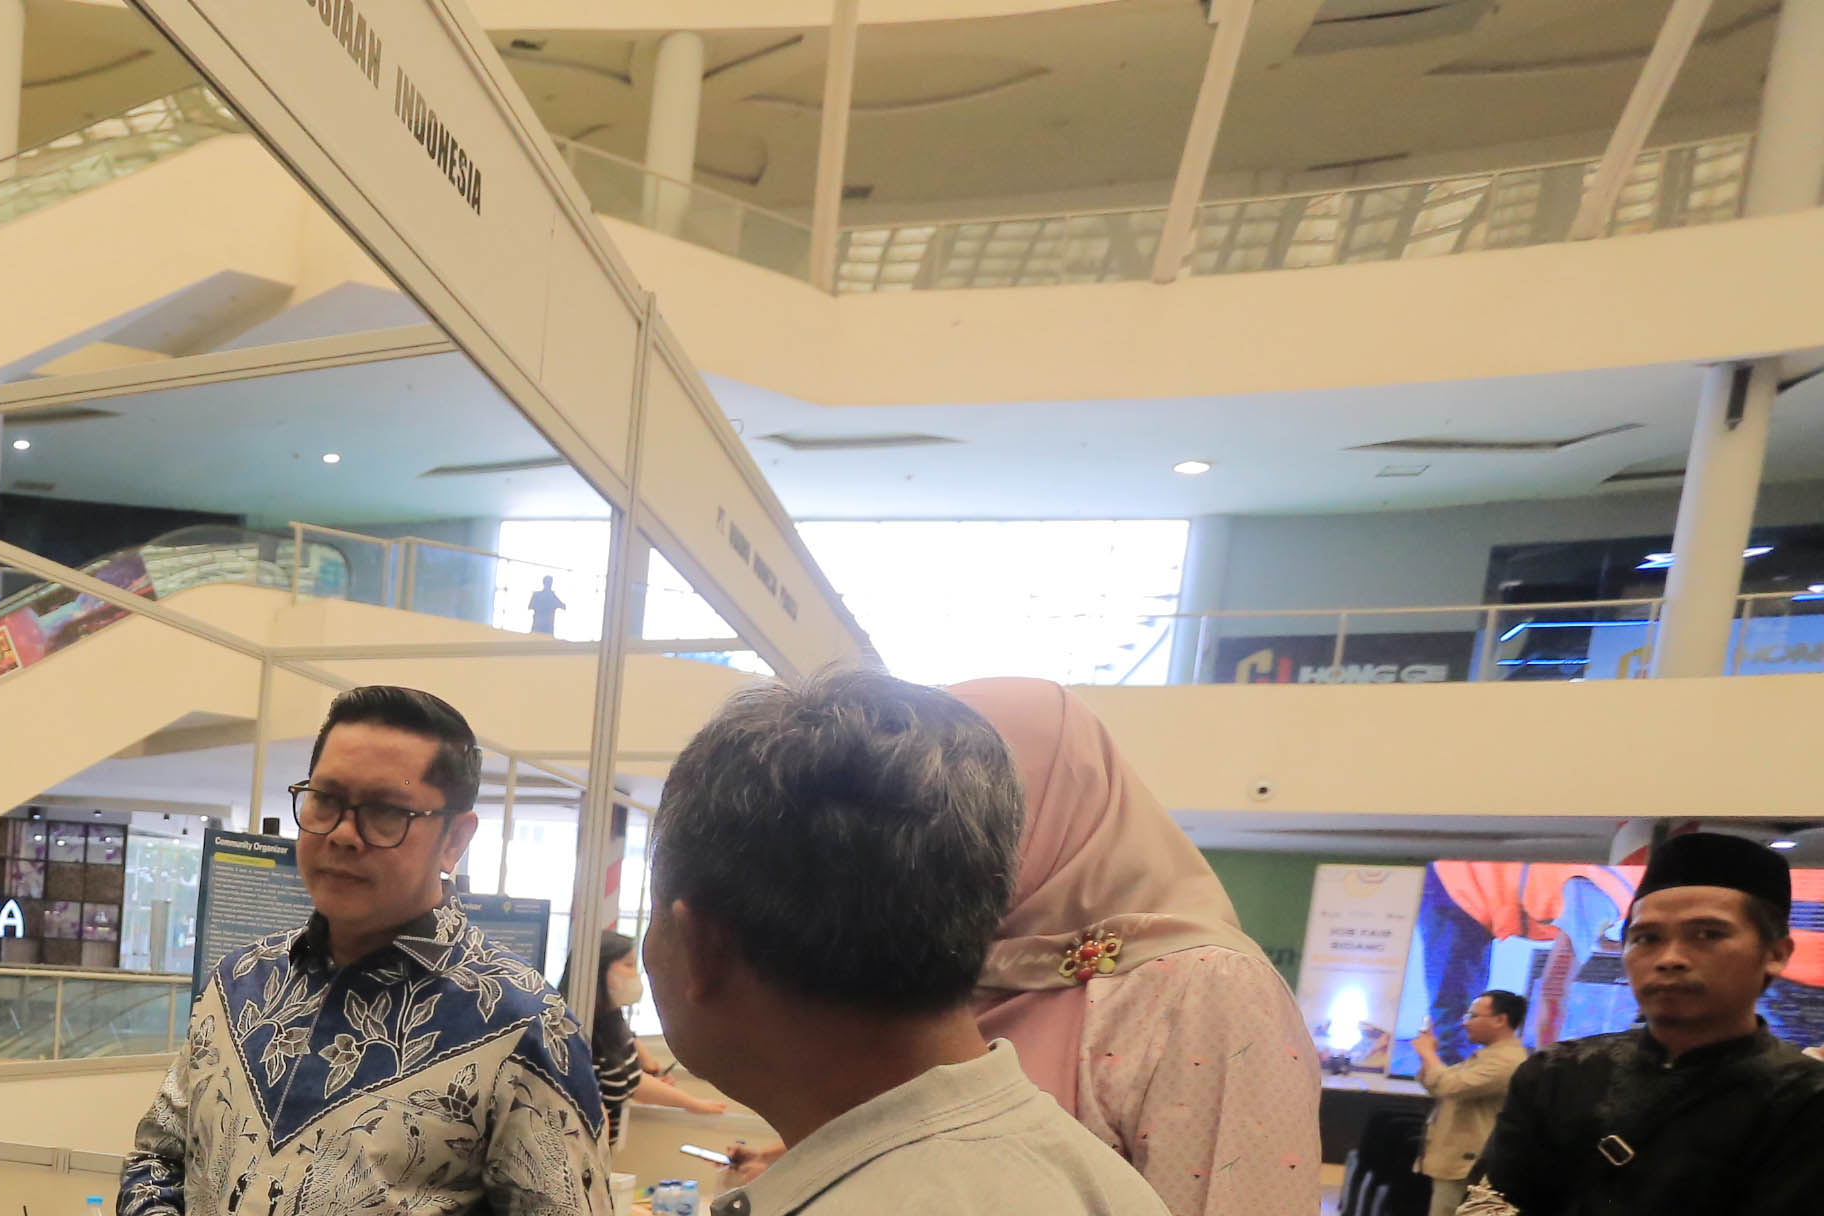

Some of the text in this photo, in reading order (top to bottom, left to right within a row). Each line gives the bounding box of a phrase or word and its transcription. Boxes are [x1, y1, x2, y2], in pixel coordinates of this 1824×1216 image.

[394, 64, 482, 217] INDONESIA
[215, 836, 289, 855] Community Organizer
